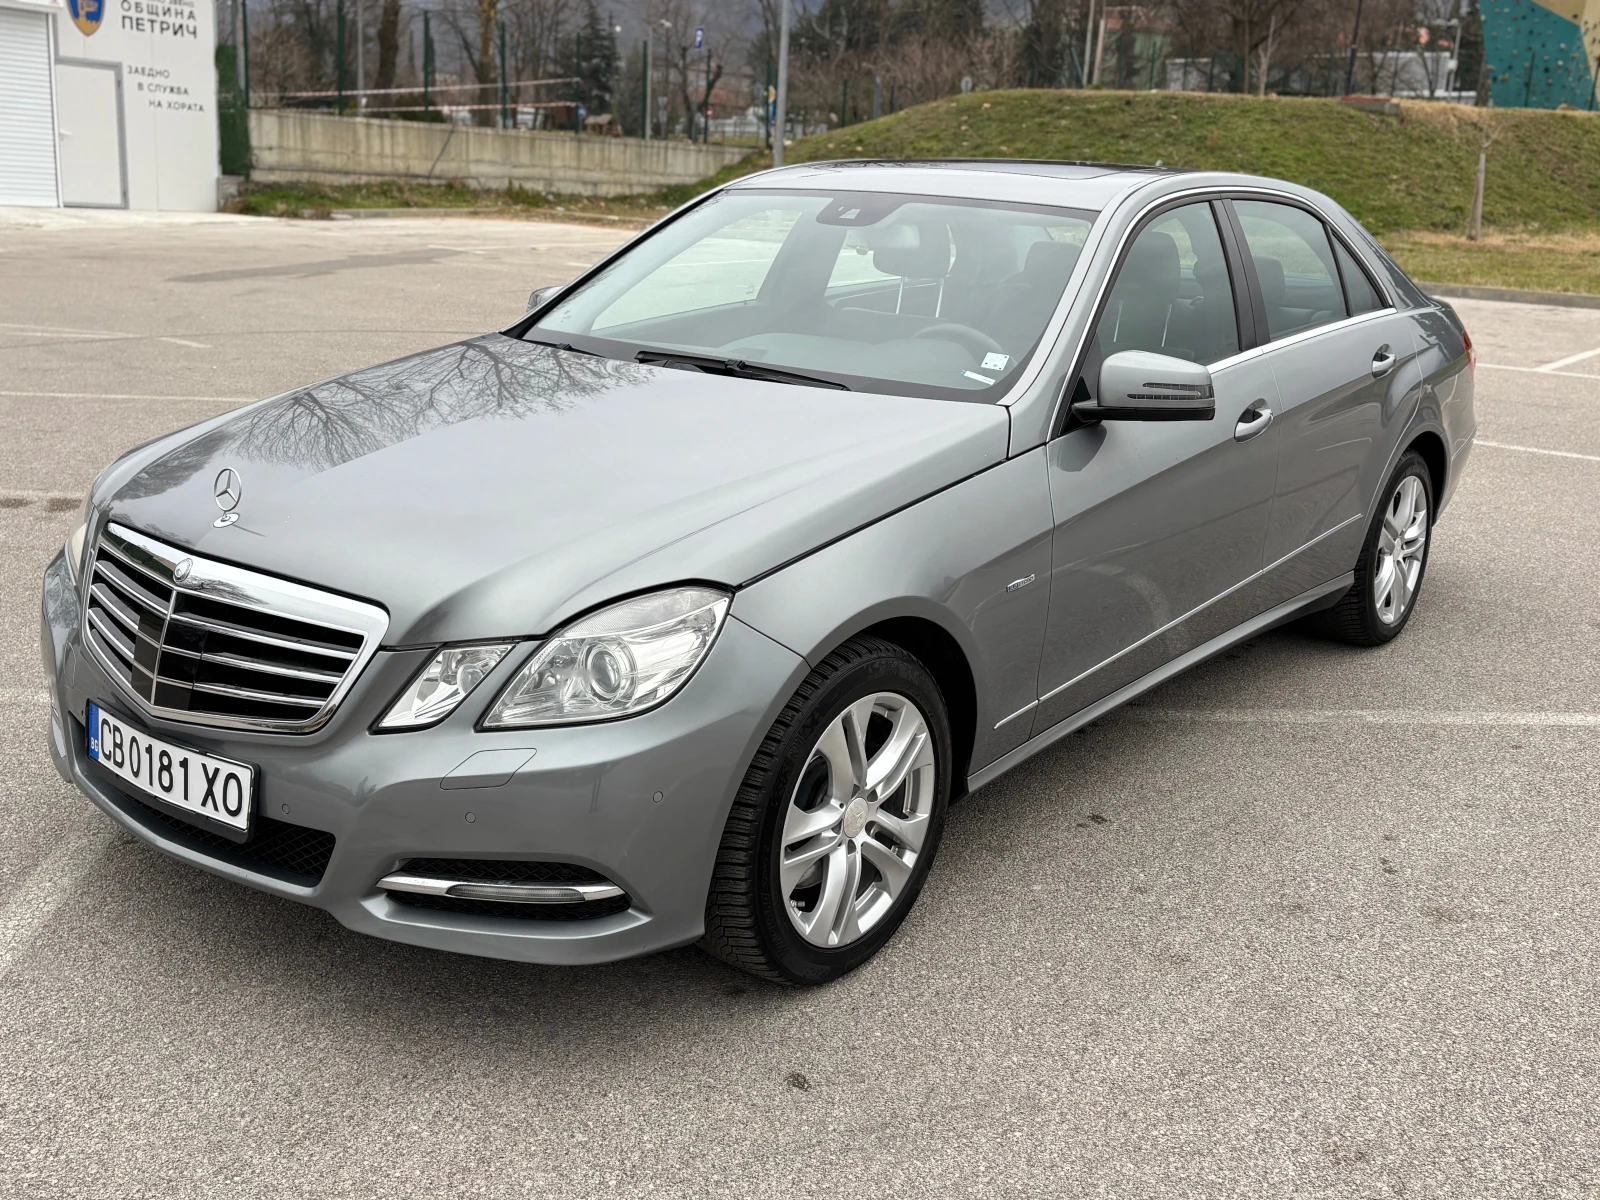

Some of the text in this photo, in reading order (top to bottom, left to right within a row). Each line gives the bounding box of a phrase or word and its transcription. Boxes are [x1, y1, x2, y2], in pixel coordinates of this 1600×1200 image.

[121, 0, 196, 21] ОБЩИНА
[122, 16, 197, 38] ПЕТРИЧ
[128, 65, 170, 78] ЗАЕДНО
[137, 81, 189, 95] В СЛУЖБА
[149, 100, 204, 112] НА ХОРАТА
[90, 737, 99, 752] BG
